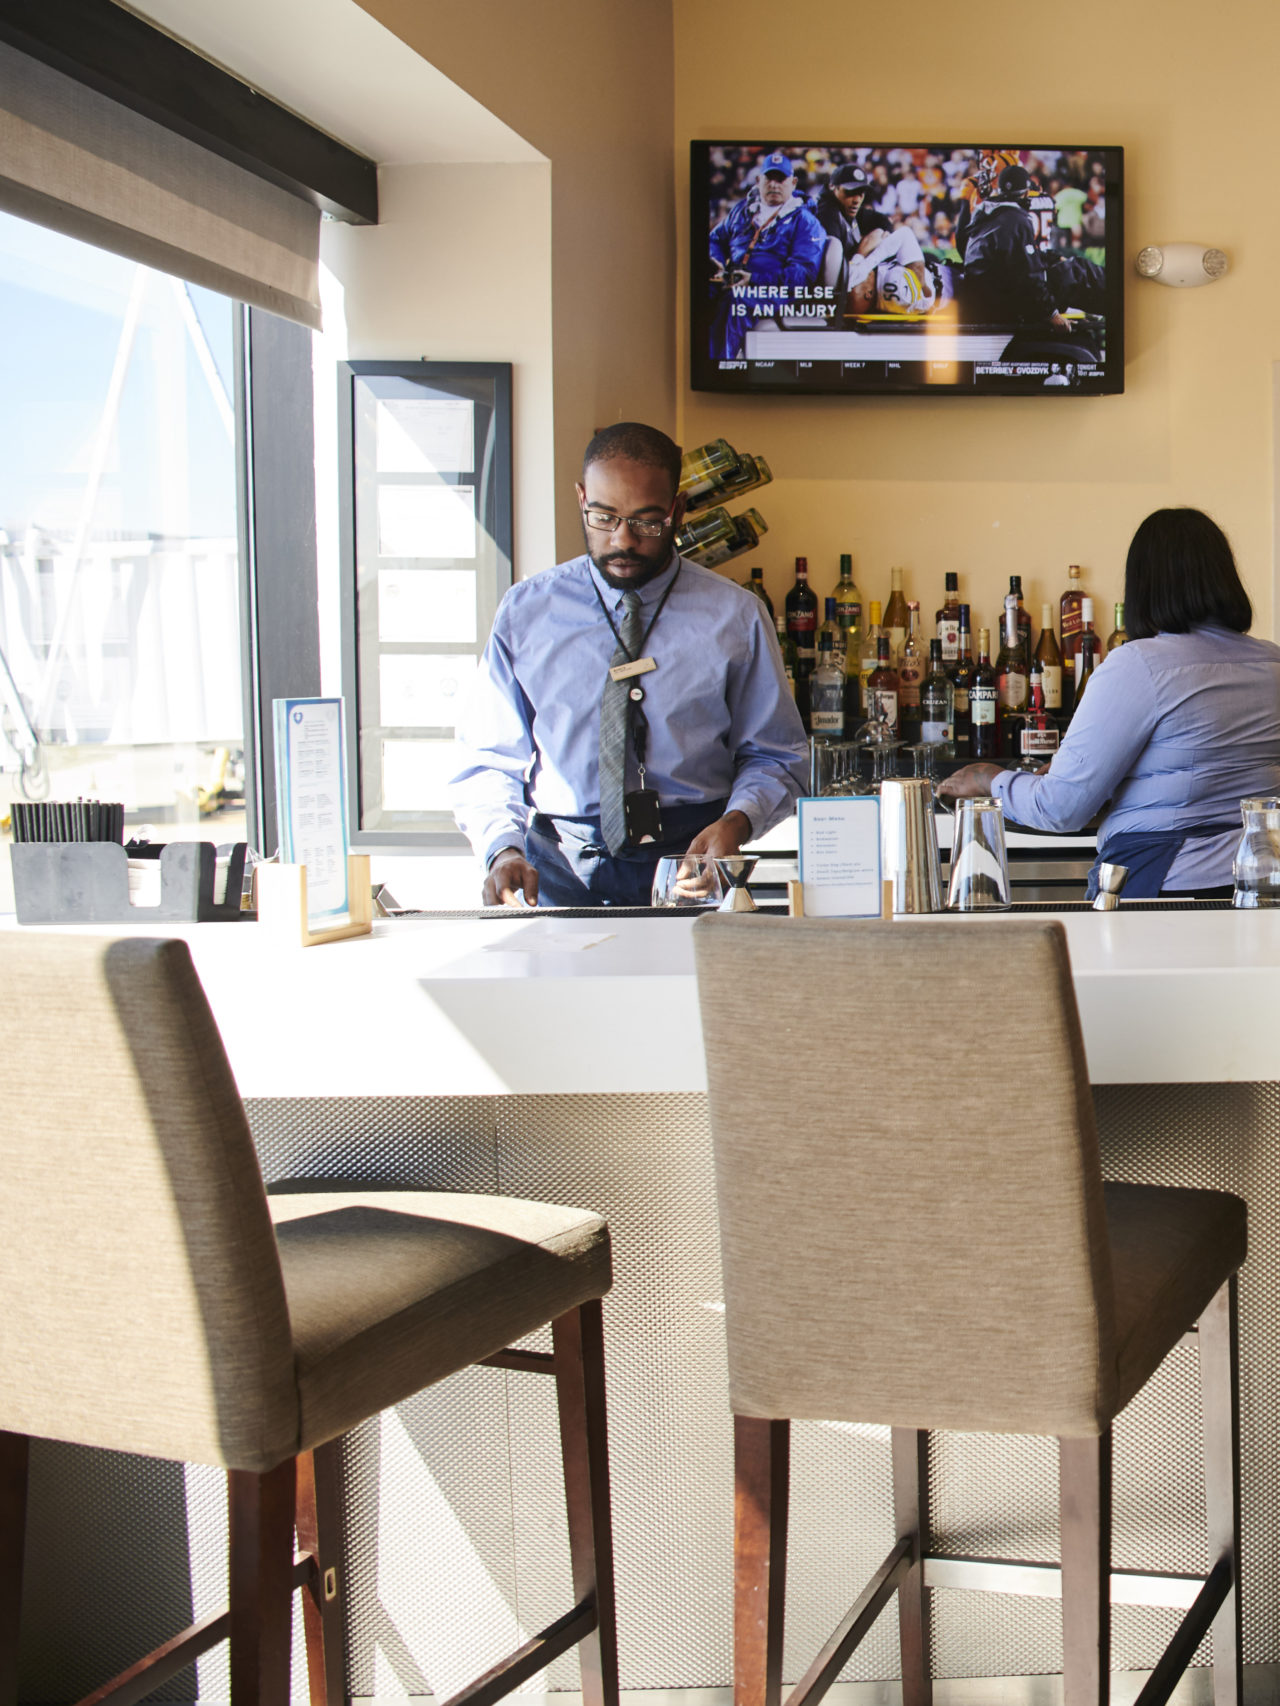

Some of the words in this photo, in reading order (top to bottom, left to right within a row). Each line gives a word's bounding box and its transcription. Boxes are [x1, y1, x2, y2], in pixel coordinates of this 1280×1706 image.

[732, 286, 789, 299] WHERE
[794, 286, 834, 299] ELSE
[883, 283, 900, 301] 50
[731, 304, 747, 317] IS
[753, 304, 774, 317] AN
[780, 304, 837, 317] INJURY
[718, 361, 747, 370] ESPN
[969, 690, 998, 699] CAMPARI
